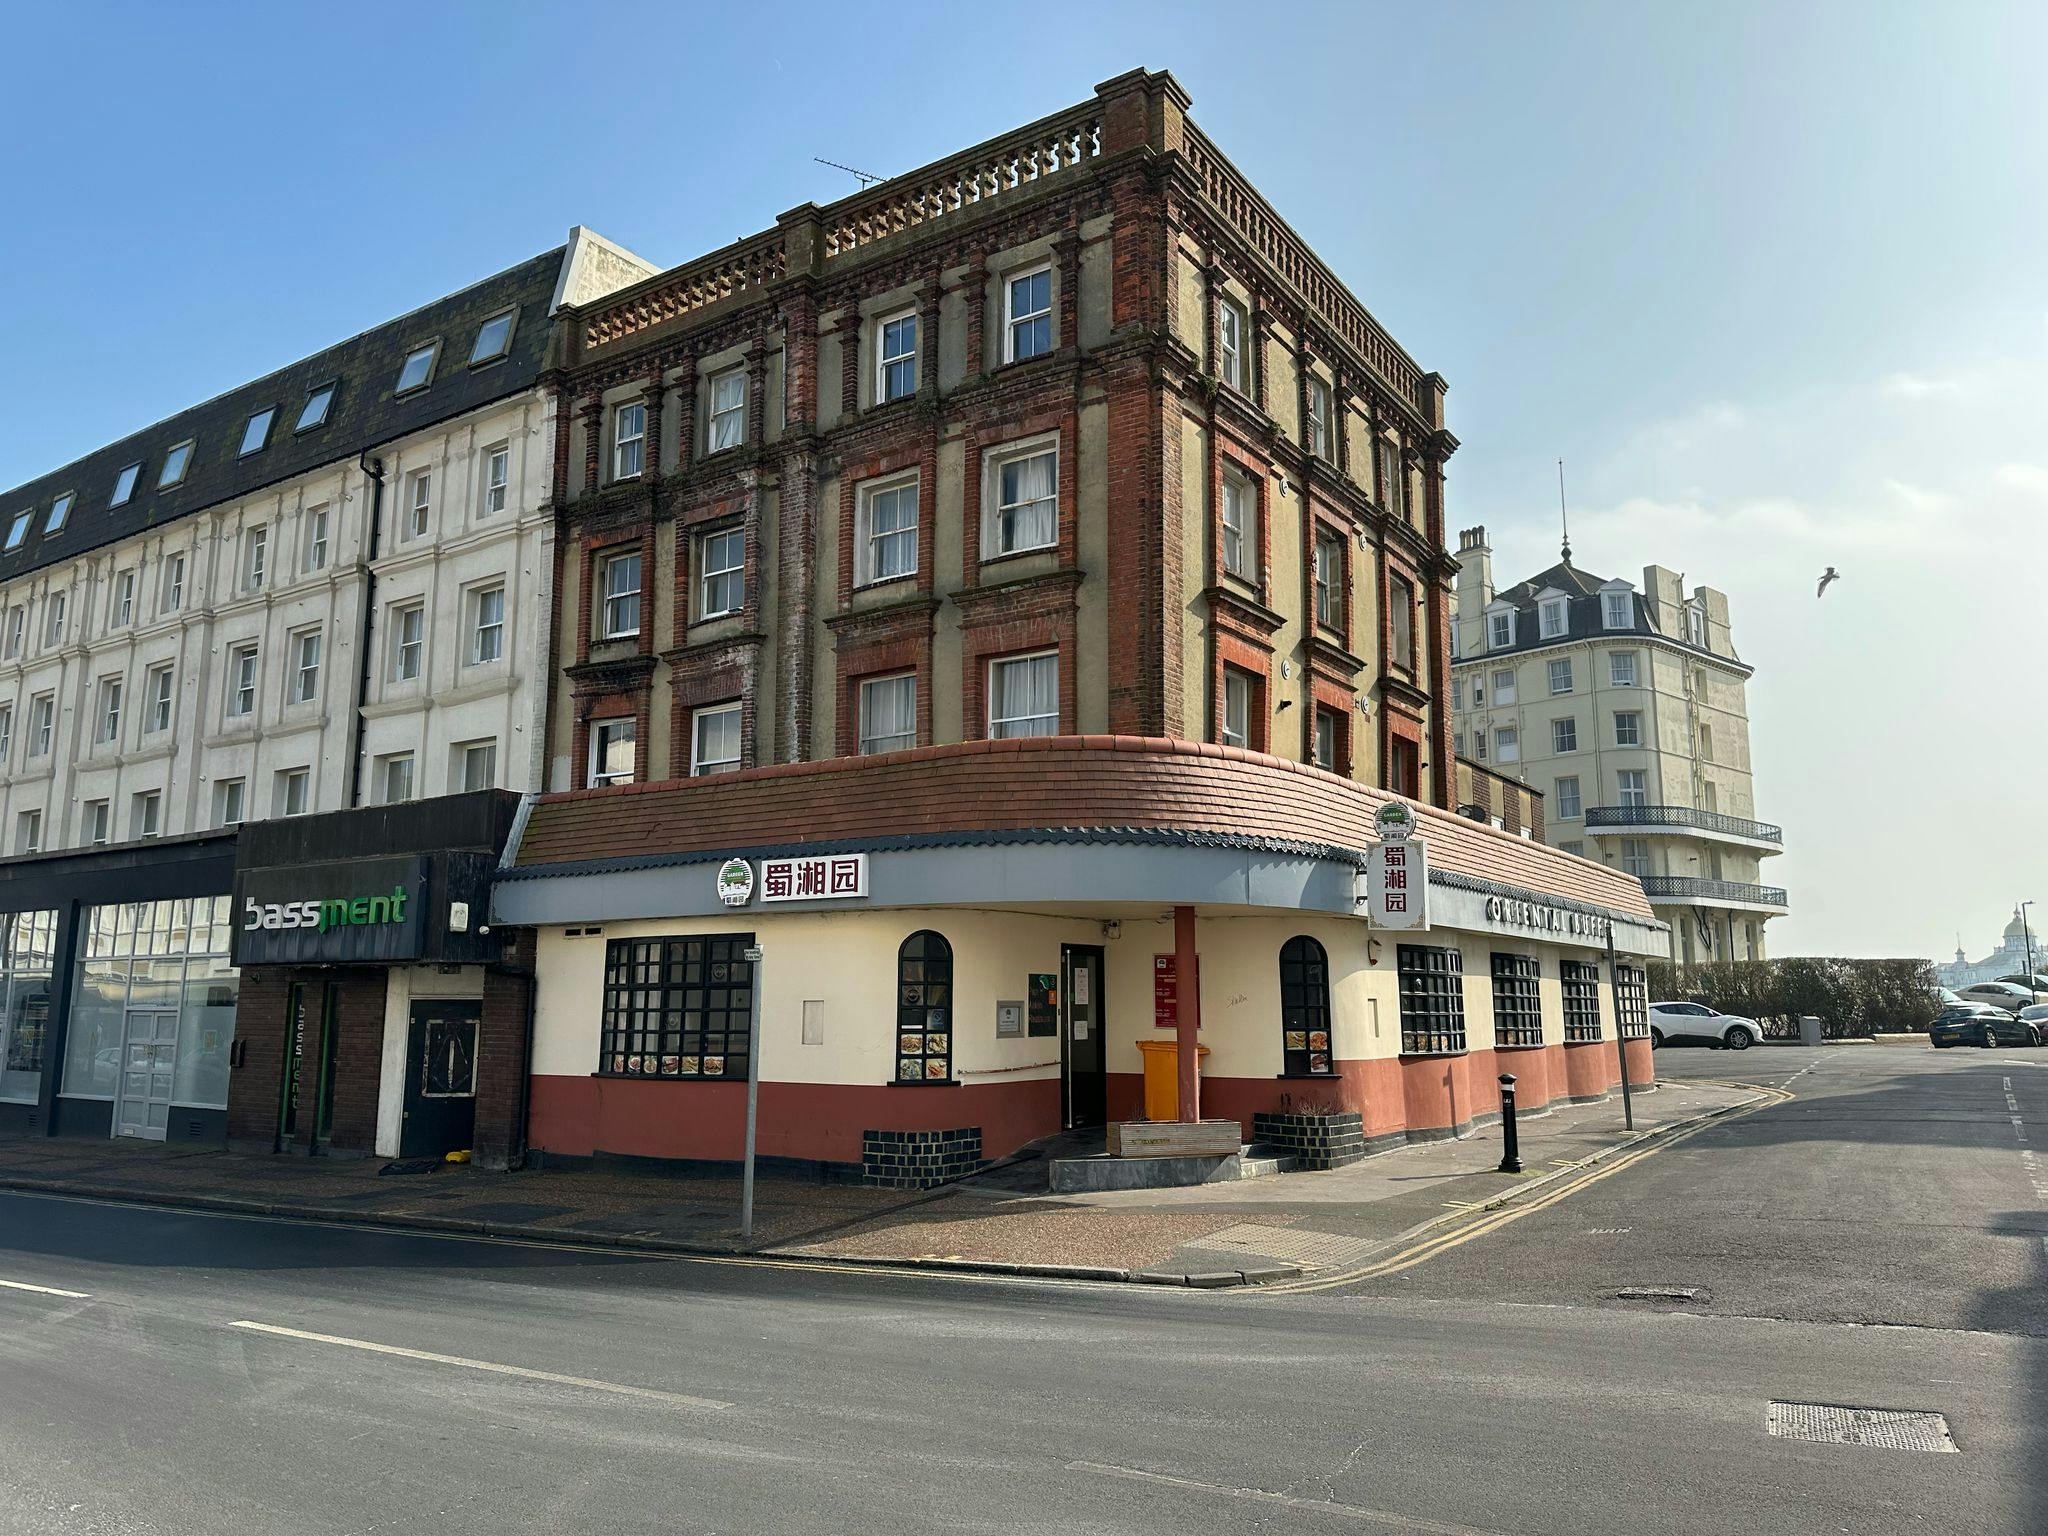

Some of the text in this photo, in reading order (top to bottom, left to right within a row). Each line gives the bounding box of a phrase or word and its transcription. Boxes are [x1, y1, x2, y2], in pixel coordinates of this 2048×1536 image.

[765, 859, 859, 897] 蜀湘园
[1384, 847, 1407, 912] 蜀湘园
[244, 885, 407, 934] bassment
[1488, 896, 1616, 938] ORIENTAL BUFFT
[292, 1004, 306, 1109] bassment
